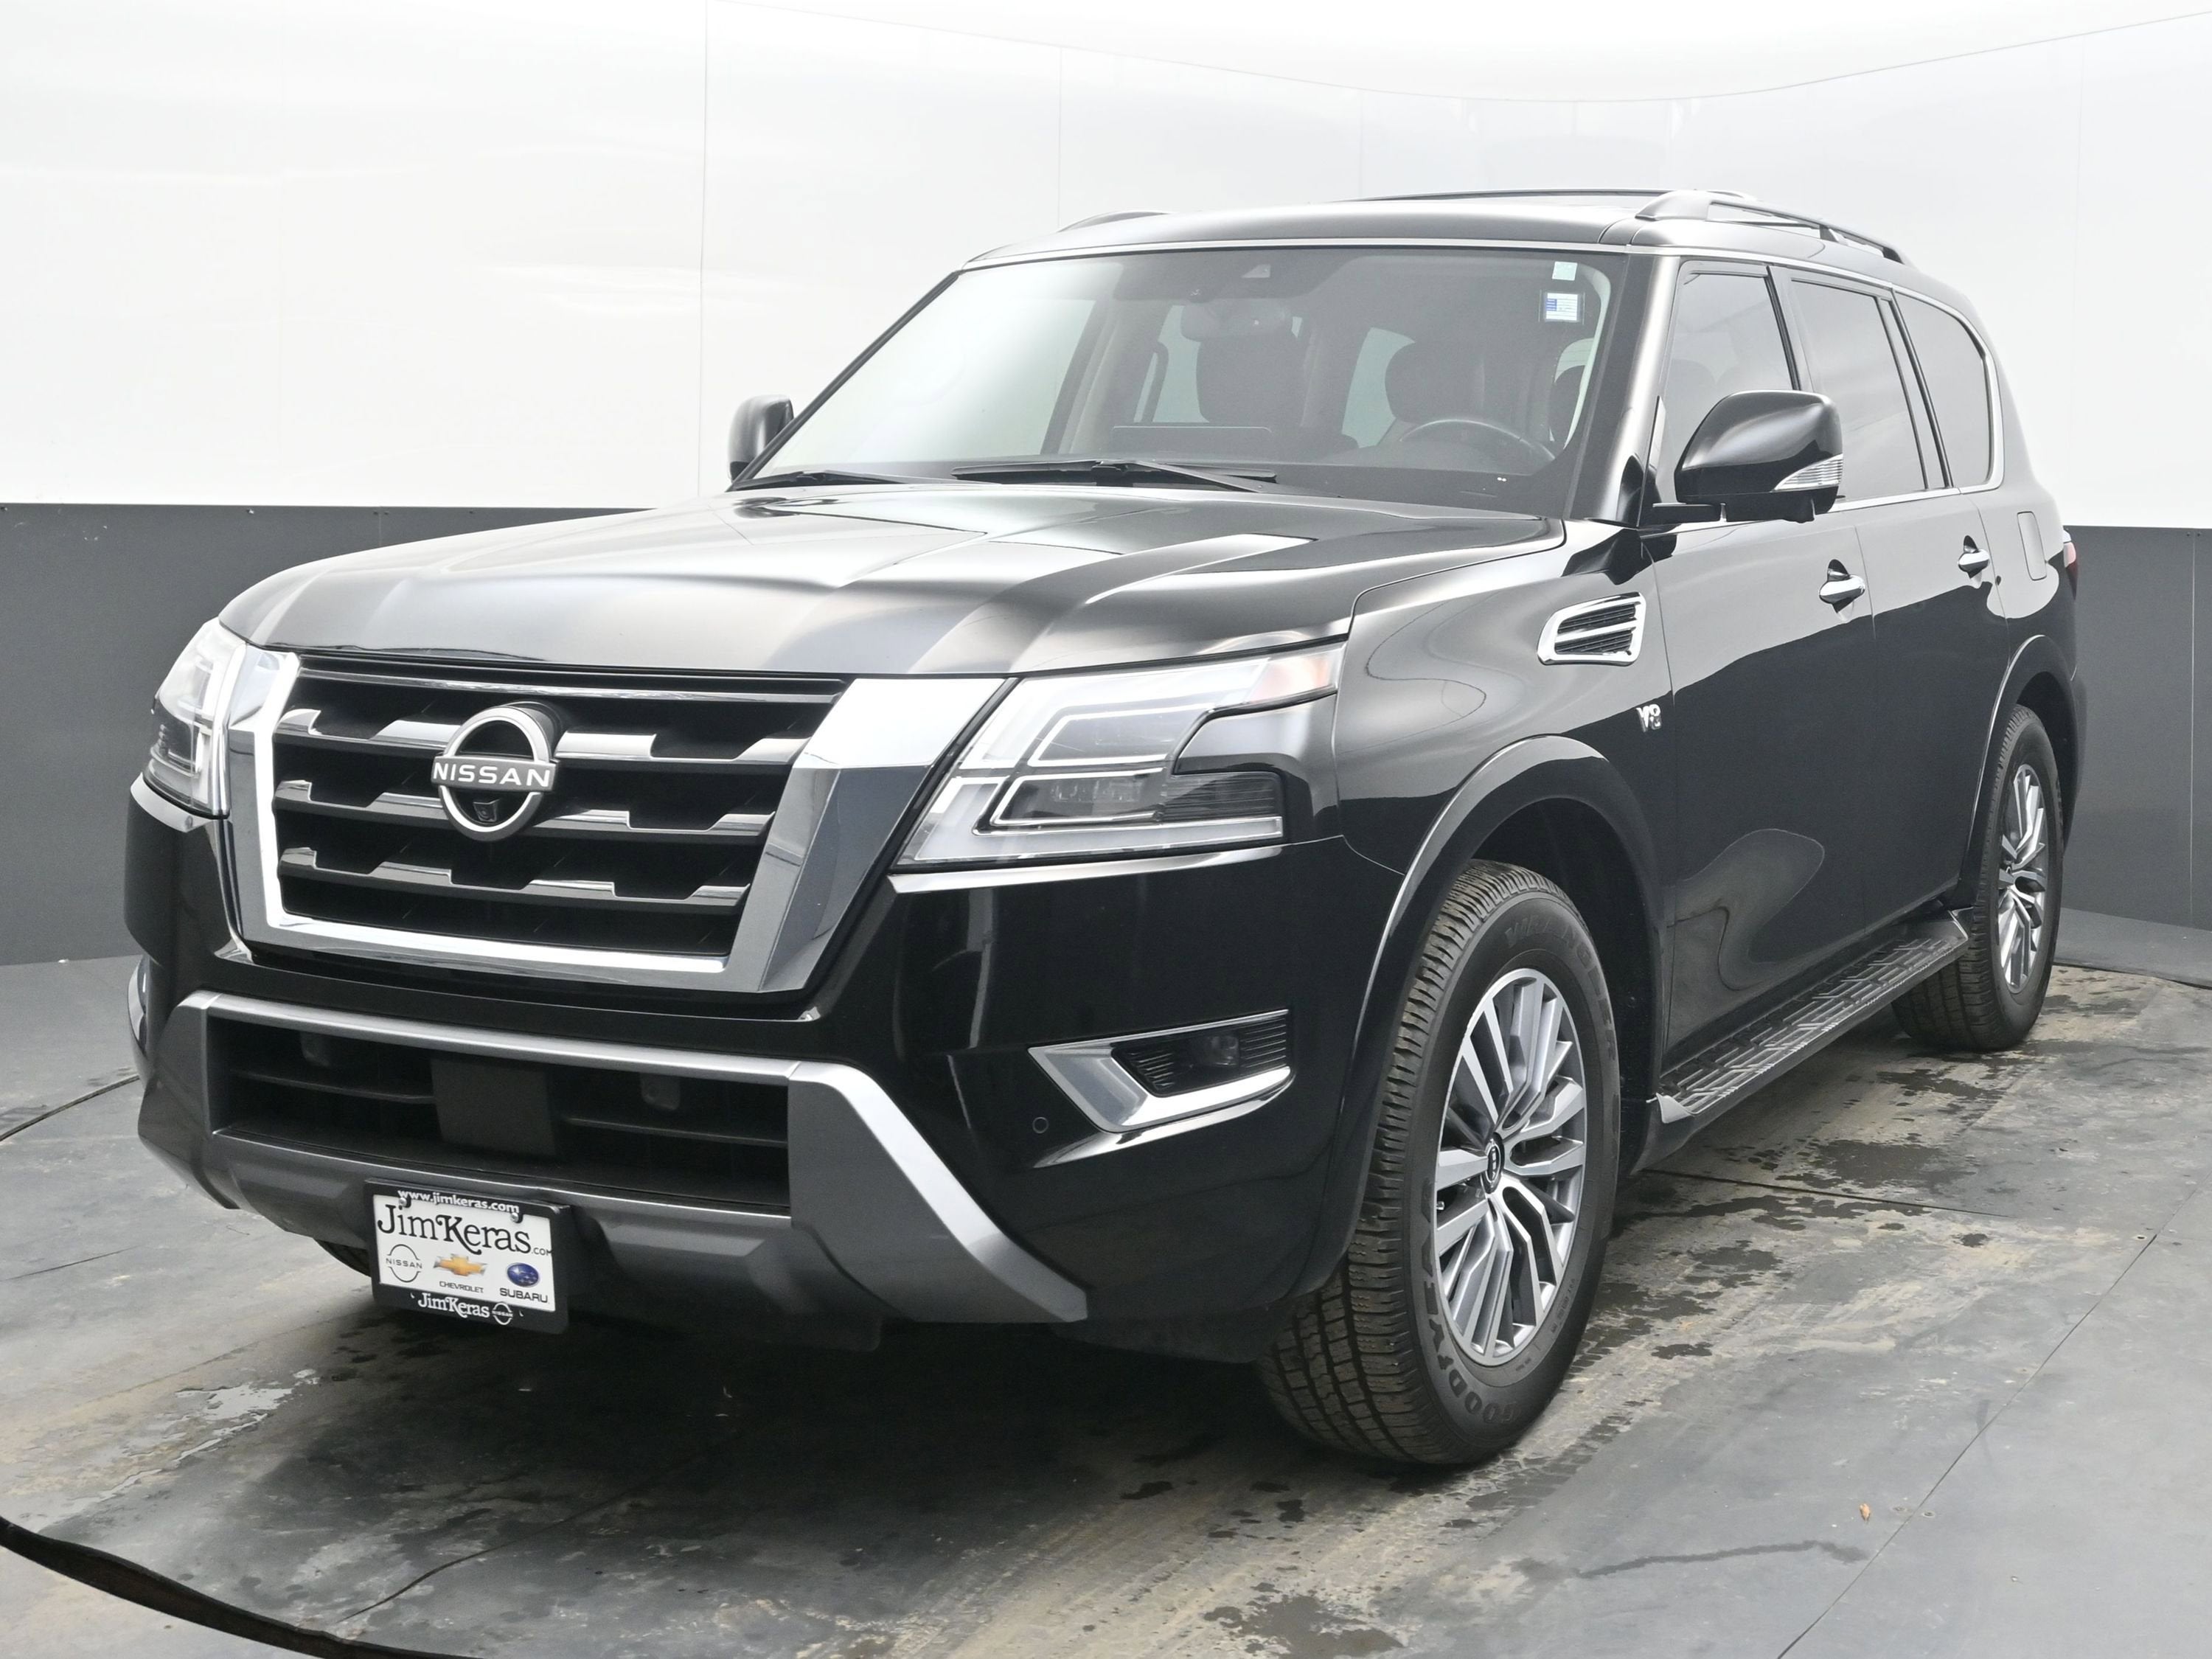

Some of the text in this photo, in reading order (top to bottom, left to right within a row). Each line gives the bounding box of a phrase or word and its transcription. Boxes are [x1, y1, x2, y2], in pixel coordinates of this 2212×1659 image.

[432, 762, 551, 787] NISSAN
[398, 1189, 520, 1214] www.jimkeras.com
[385, 1258, 422, 1269] NISSAN
[439, 1281, 484, 1293] CHEVROLET
[499, 1287, 548, 1303] SUBARU
